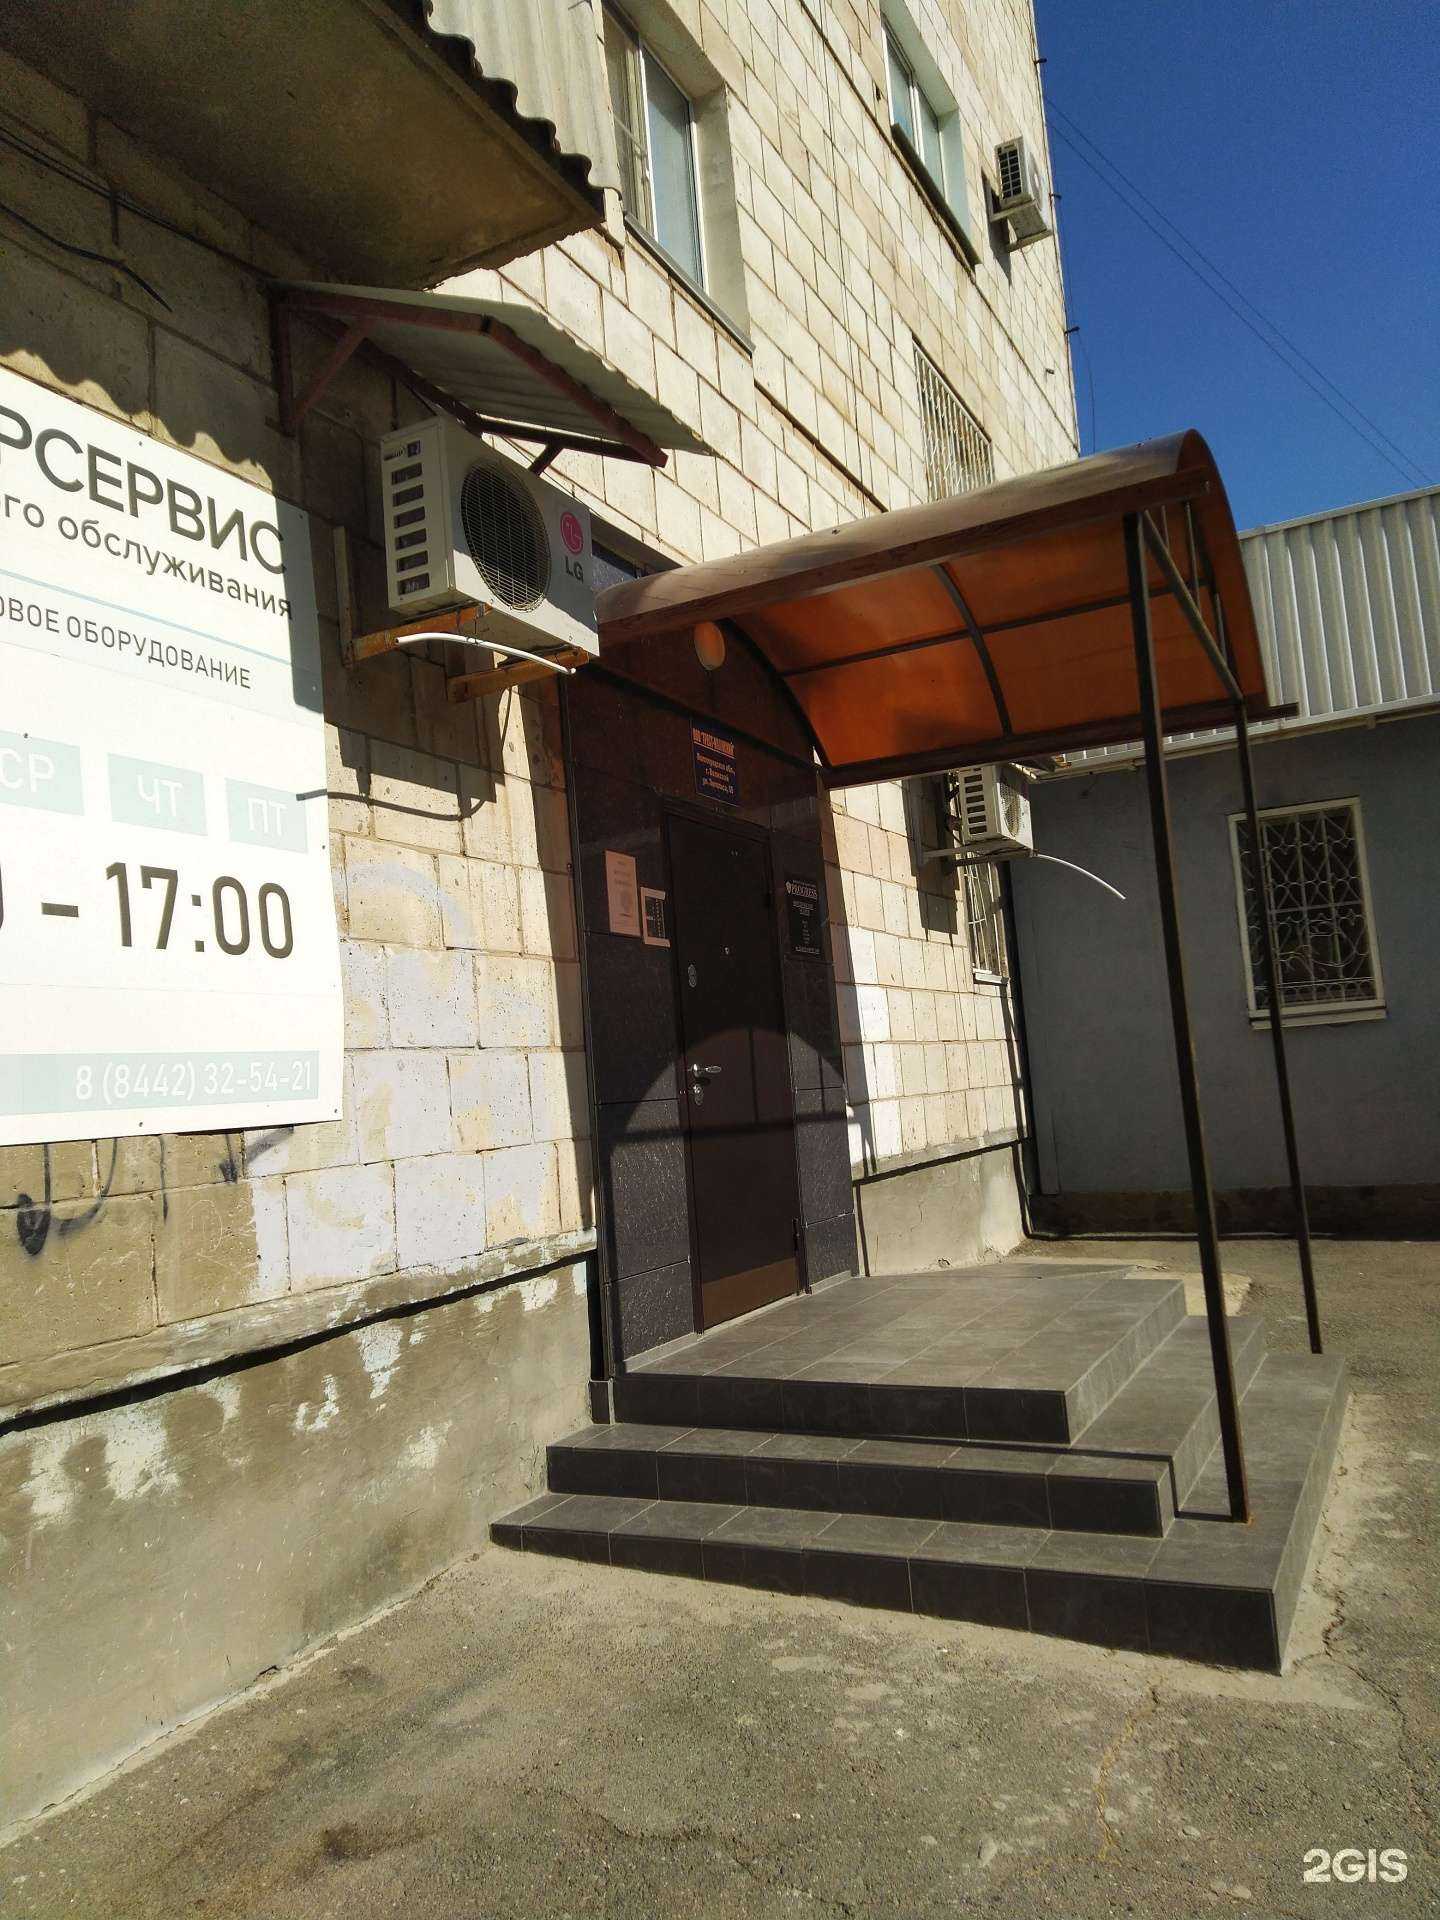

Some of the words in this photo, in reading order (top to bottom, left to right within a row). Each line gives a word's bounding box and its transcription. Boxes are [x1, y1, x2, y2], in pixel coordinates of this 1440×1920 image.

[57, 516, 293, 619] обслуживания
[565, 558, 584, 584] LG
[66, 616, 252, 690] ОБОРУДОВАНИЕ
[137, 774, 183, 818] ЧТ
[247, 797, 289, 836] ПТ
[106, 862, 295, 959] 17:00
[75, 1065, 93, 1101] 8
[103, 1060, 197, 1103] (8442)
[203, 1059, 311, 1096] 32-54-21
